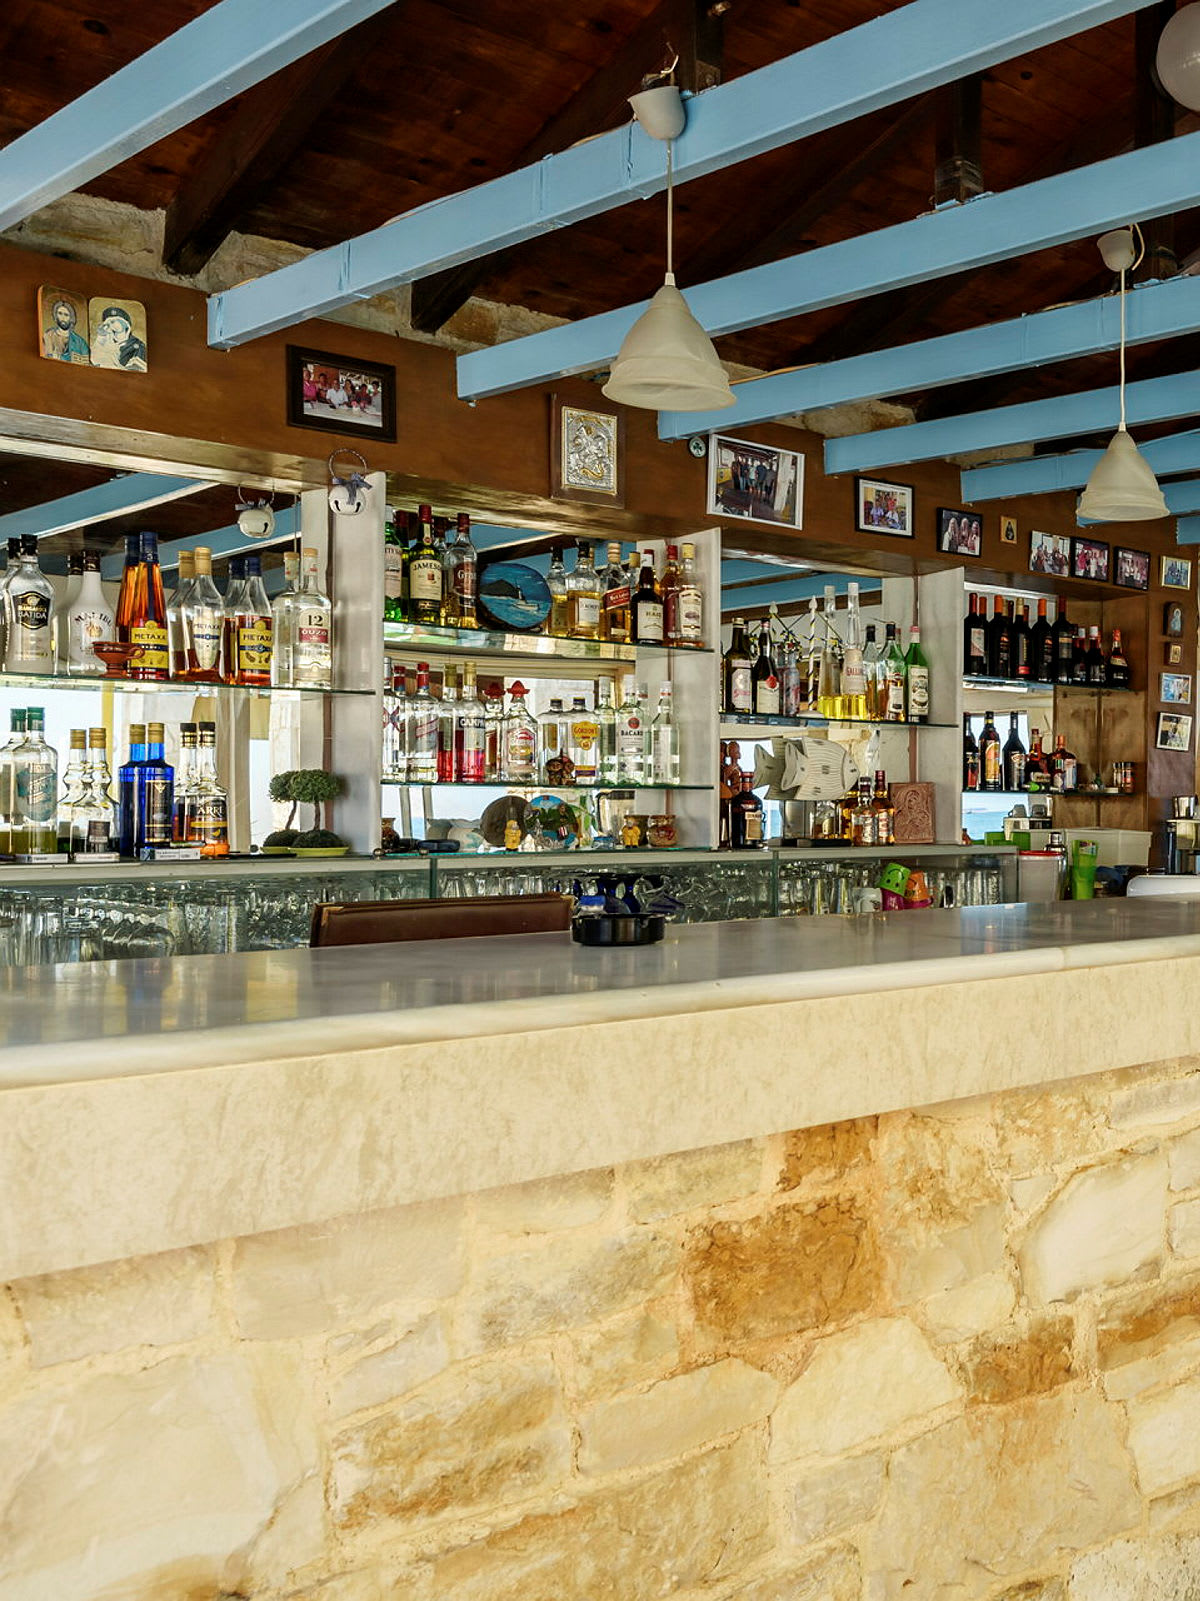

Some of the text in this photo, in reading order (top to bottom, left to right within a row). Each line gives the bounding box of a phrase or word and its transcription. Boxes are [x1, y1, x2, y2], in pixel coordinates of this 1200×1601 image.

[18, 610, 47, 620] BATIDA
[308, 614, 324, 627] 12
[301, 628, 327, 636] OUZO
